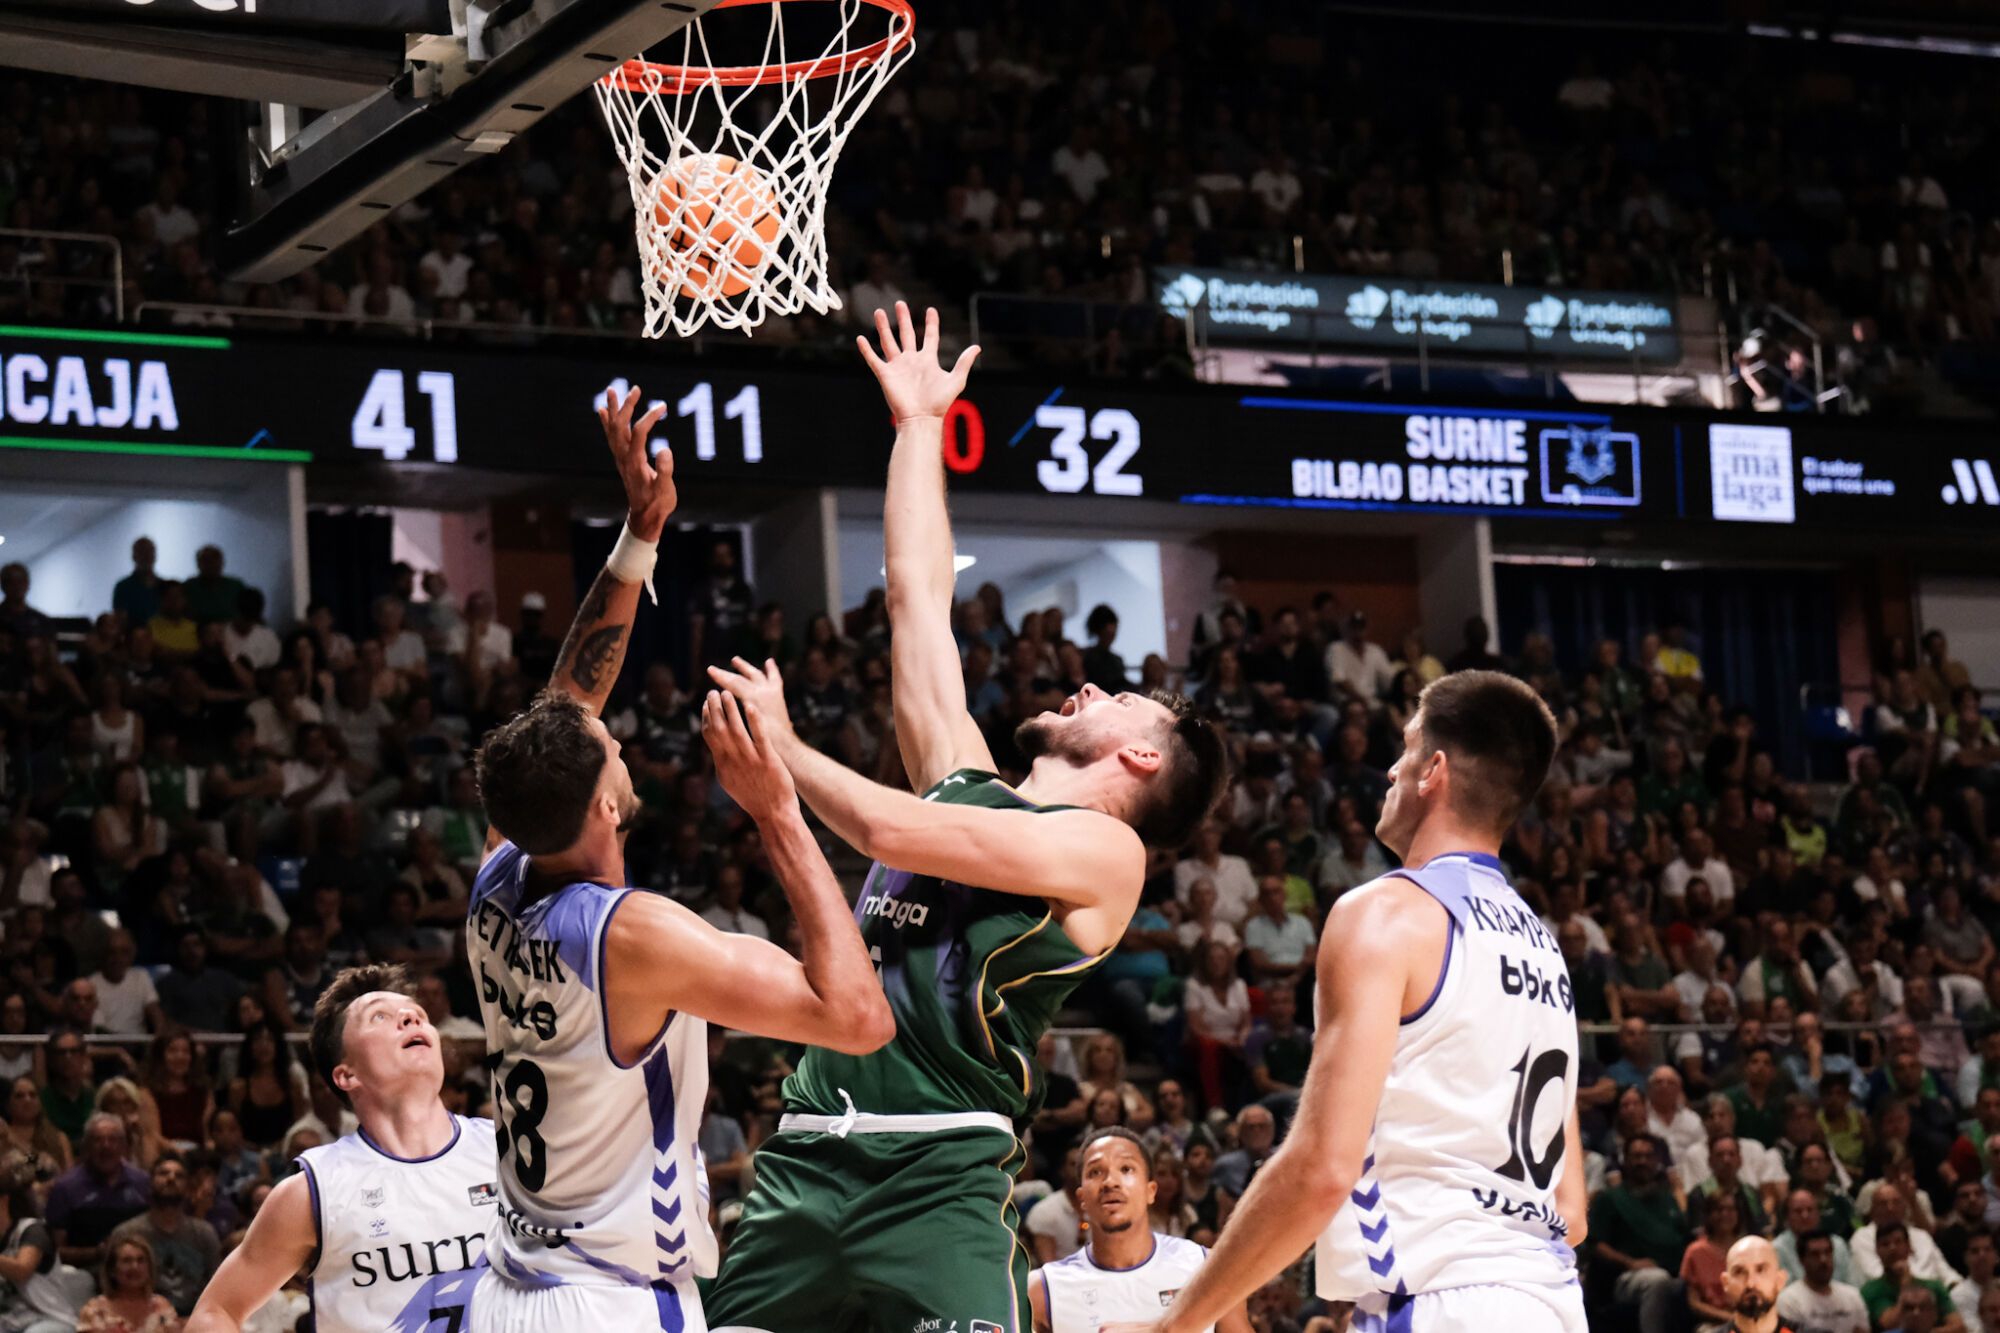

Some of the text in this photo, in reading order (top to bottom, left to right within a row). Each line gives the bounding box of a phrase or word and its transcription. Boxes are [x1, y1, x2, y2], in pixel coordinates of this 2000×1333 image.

[0, 353, 179, 431] CAJA
[352, 368, 458, 463] 41
[1035, 404, 1143, 497] 32
[1405, 415, 1528, 463] SURNE
[1291, 458, 1529, 506] BILBAO BASKET
[1500, 954, 1558, 1008] bbk
[1494, 1043, 1569, 1191] 10
[352, 1232, 492, 1288] surn
